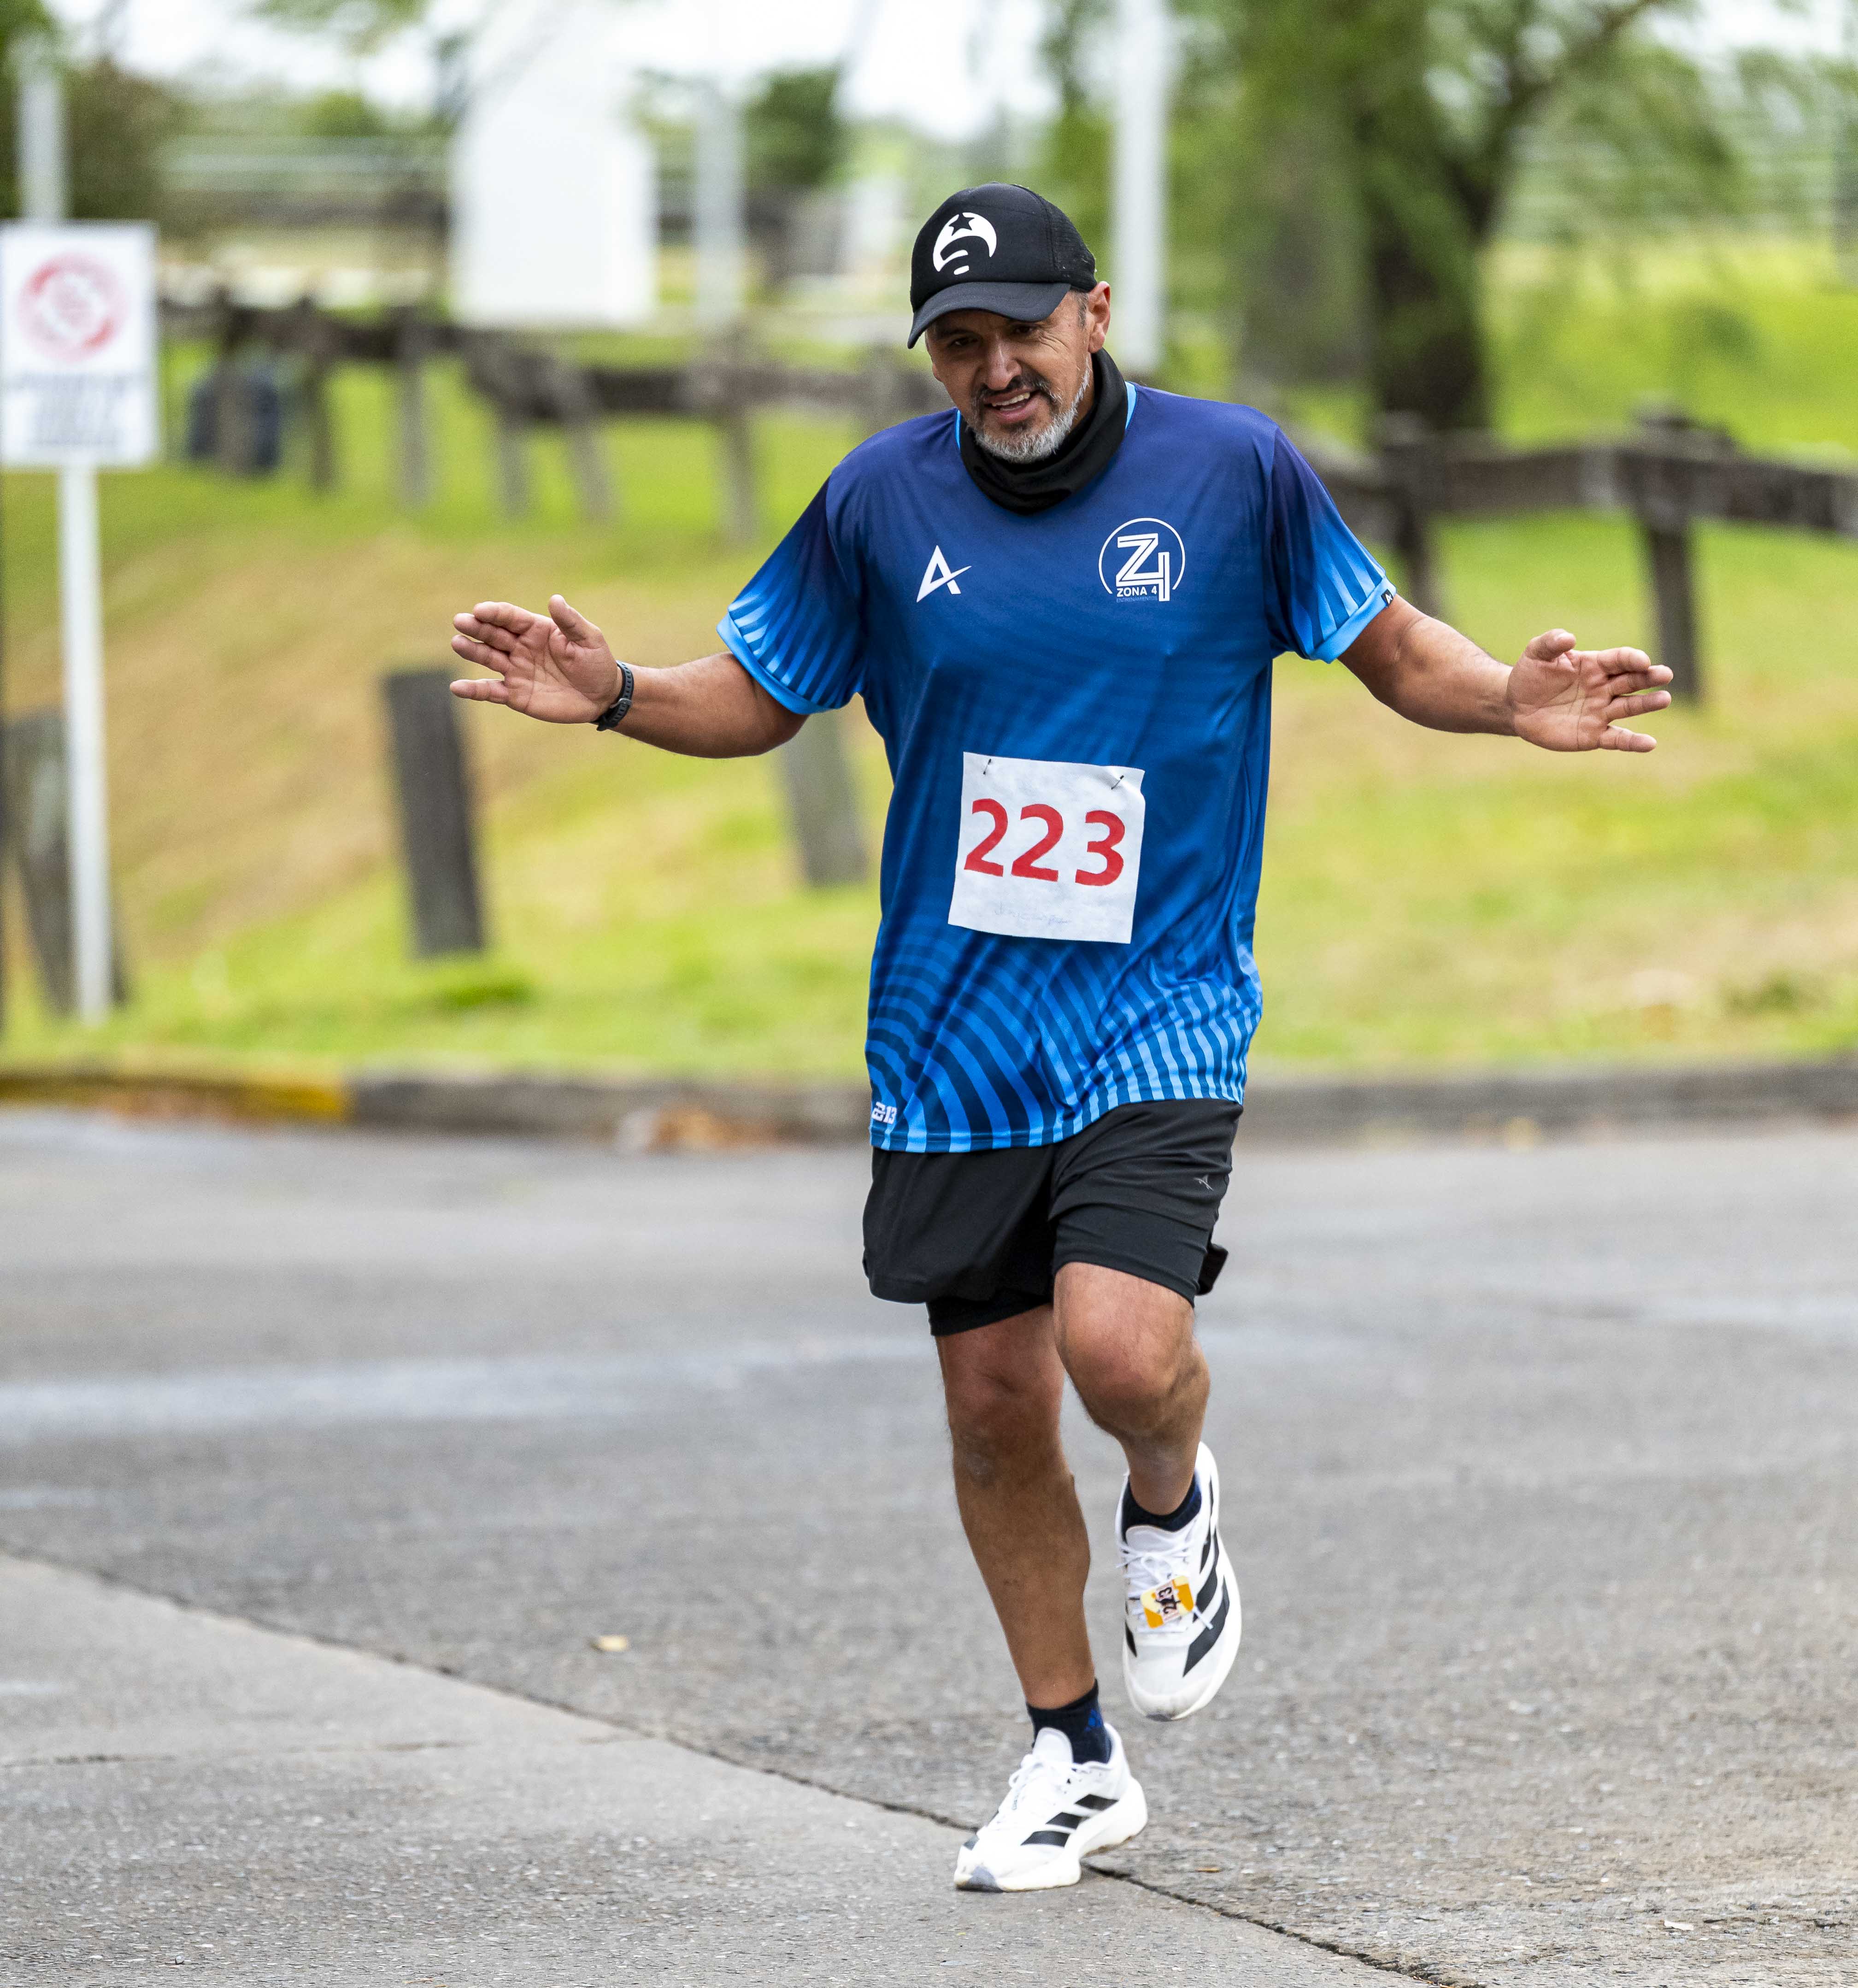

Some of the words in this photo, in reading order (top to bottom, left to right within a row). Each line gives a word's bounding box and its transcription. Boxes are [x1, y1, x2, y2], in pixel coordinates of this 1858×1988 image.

[1117, 586, 1147, 597] ZONA
[1152, 586, 1157, 595] 4
[964, 798, 1125, 886] 223
